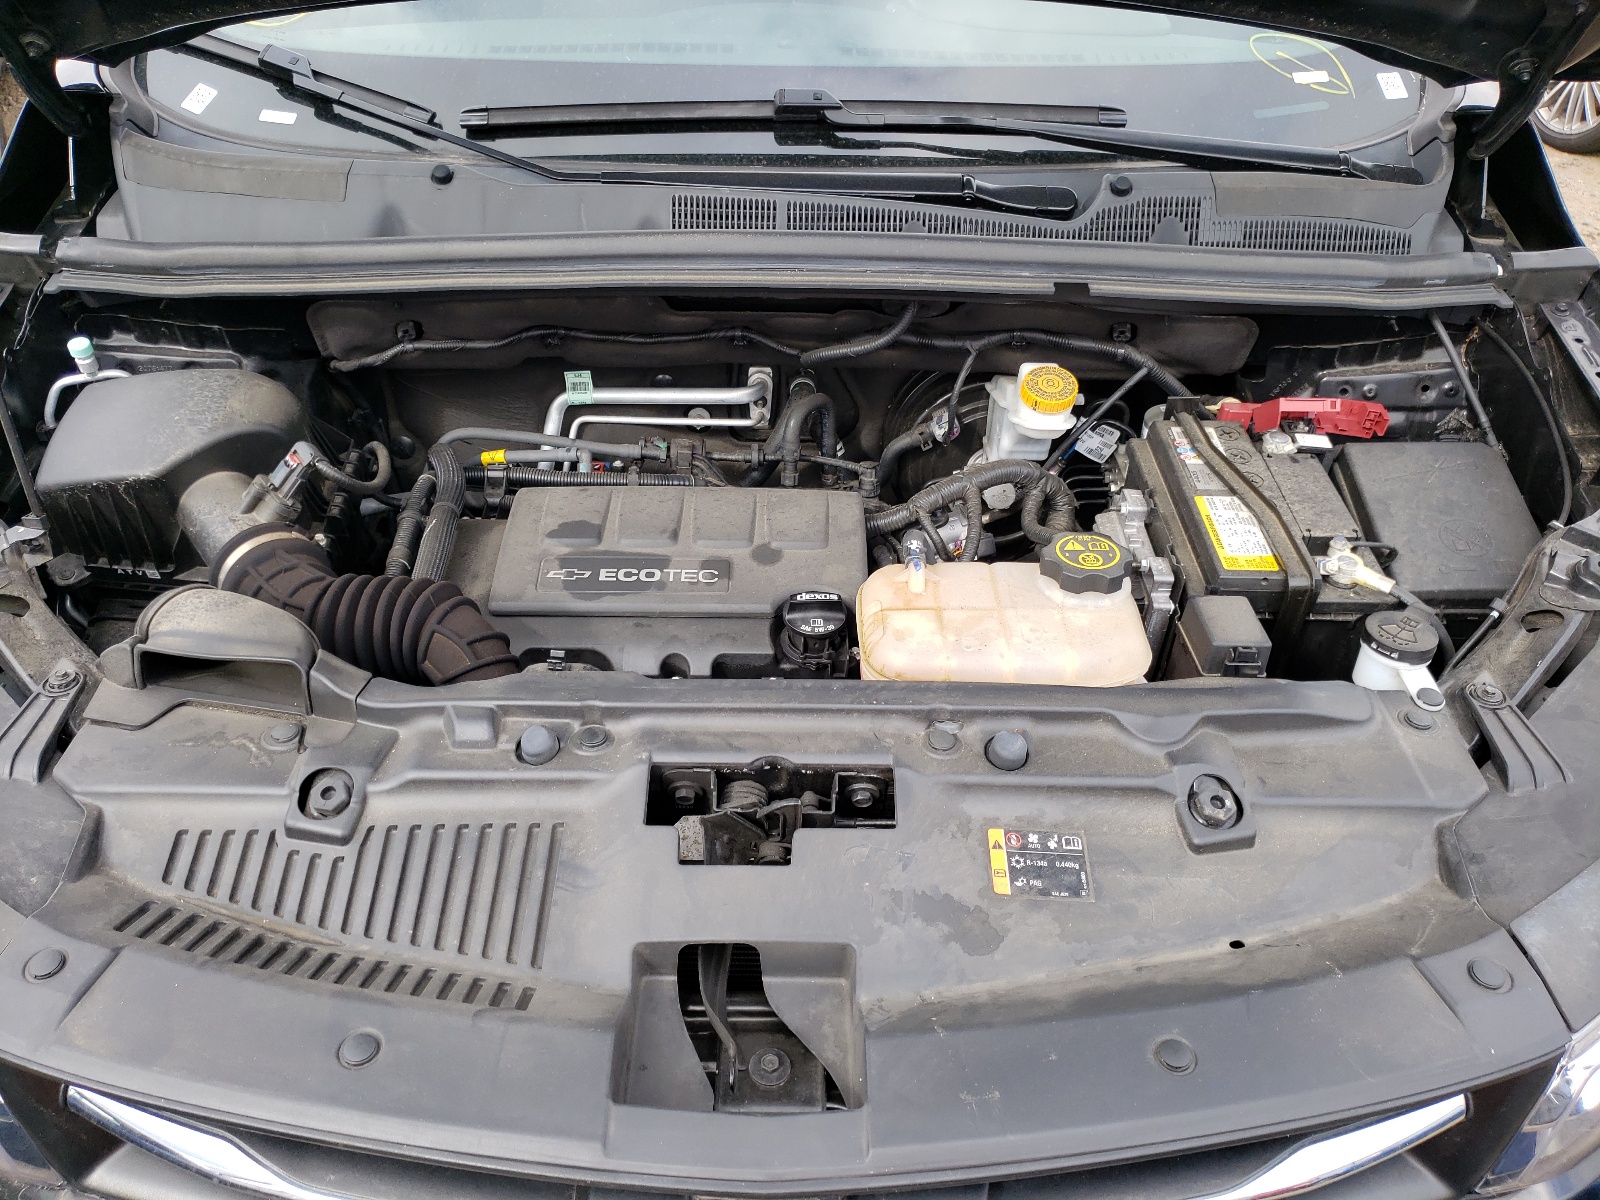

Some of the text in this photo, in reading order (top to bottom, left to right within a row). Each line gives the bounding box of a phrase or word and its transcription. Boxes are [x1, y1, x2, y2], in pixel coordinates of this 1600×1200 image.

[599, 568, 719, 583] ECOTEC
[796, 592, 839, 601] dexos
[800, 624, 813, 632] SAE
[1026, 859, 1048, 867] R-134a
[1029, 879, 1042, 887] PAG
